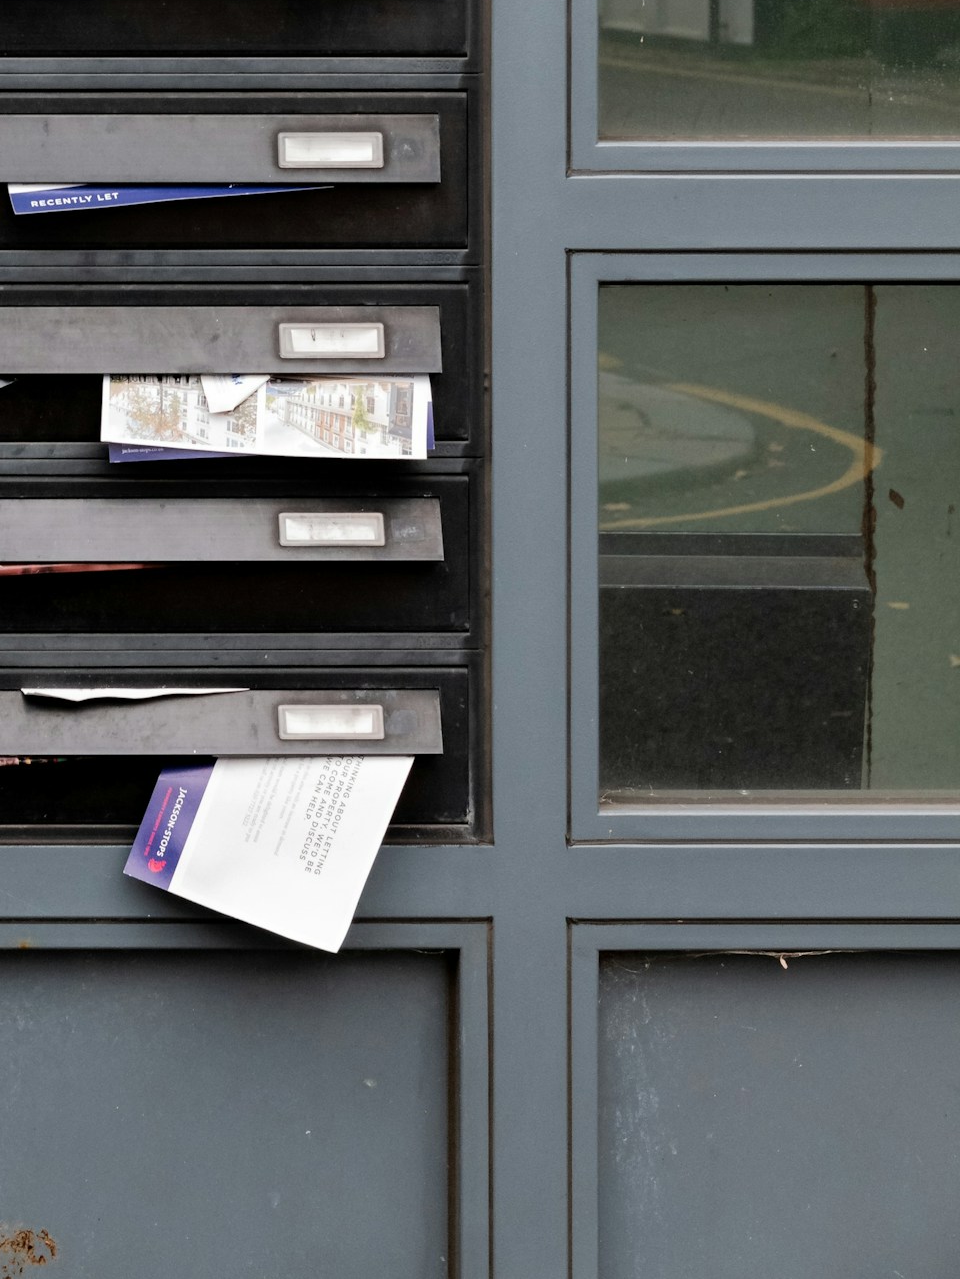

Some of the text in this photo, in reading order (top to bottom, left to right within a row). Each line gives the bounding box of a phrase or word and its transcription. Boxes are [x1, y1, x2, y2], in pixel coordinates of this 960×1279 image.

[30, 192, 119, 208] RECENTLY LET
[313, 773, 326, 794] CAN
[323, 769, 338, 796] COME
[302, 795, 318, 821] HELP.
[312, 753, 364, 876] THINKING ABOUT LETTING
[314, 797, 327, 818] AND
[155, 786, 187, 858] JACKSON-STOPS
[298, 820, 318, 861] DISCUSS
[303, 860, 313, 873] BE
